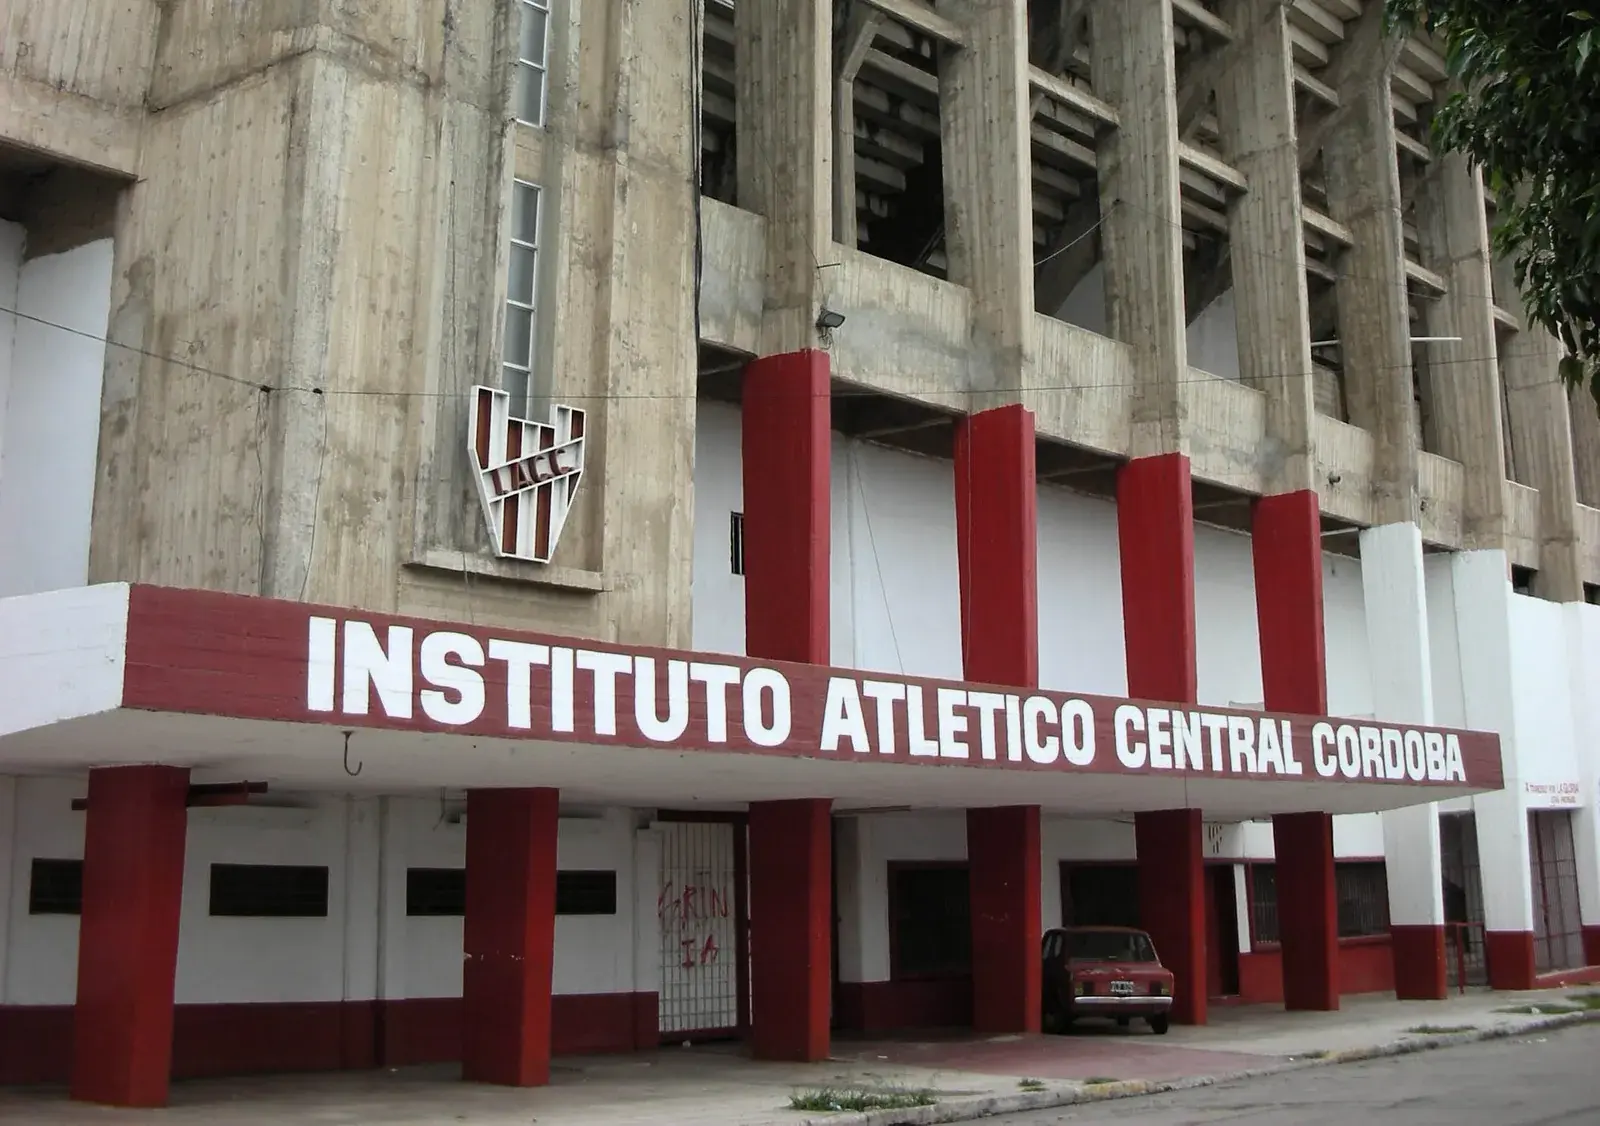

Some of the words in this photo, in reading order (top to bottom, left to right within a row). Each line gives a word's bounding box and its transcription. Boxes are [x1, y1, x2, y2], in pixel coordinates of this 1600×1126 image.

[308, 616, 791, 747] INSTITUTO
[820, 677, 1096, 766] ATLETICO
[1115, 705, 1302, 775] CENTRAL
[1312, 722, 1467, 782] CORDOBA
